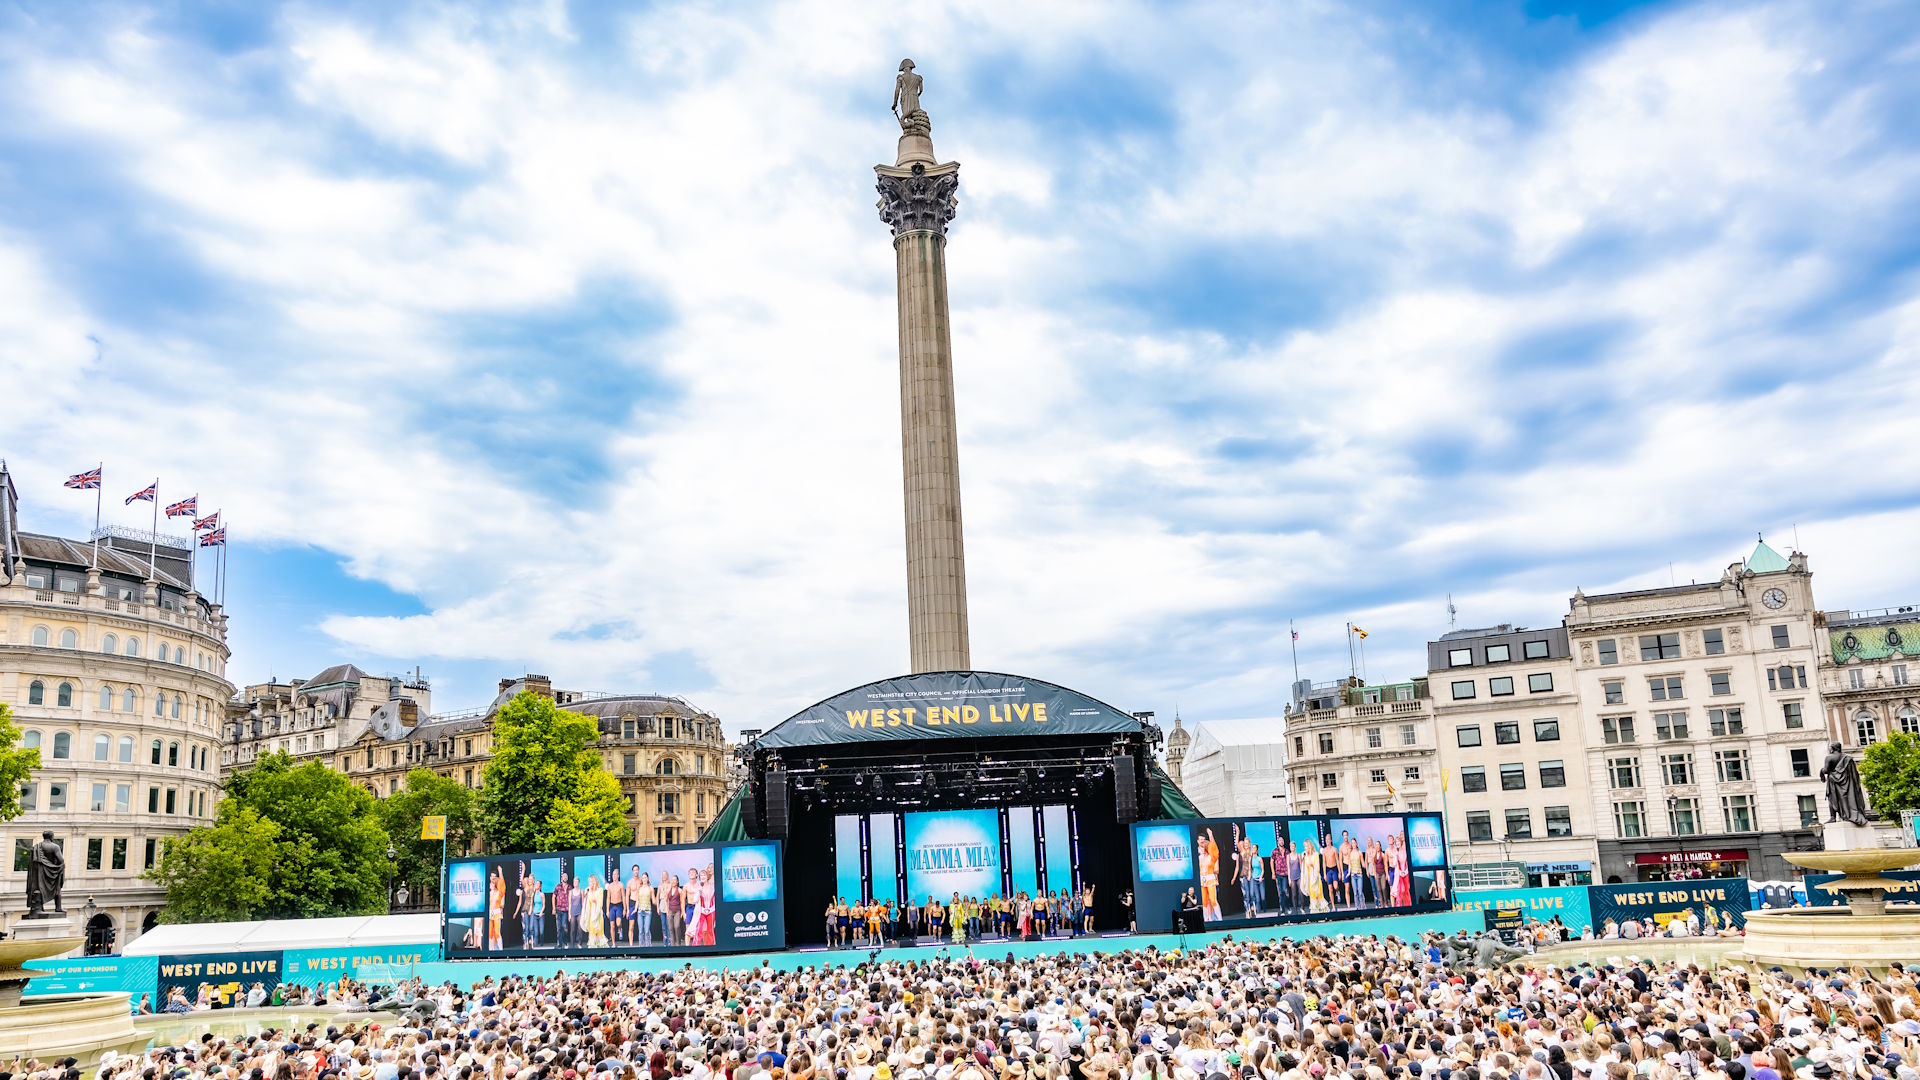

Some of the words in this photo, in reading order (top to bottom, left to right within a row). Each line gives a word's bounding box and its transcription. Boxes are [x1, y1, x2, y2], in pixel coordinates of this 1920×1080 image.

[1592, 602, 1660, 617] CANADIAN
[1666, 595, 1721, 609] PACIFIC
[867, 690, 904, 698] WESTMINSTER
[846, 707, 917, 729] WEST
[926, 704, 981, 726] END
[989, 702, 1048, 723] LIVE
[1411, 836, 1430, 847] MAMMA
[909, 847, 962, 870] MAMMA
[965, 846, 997, 868] MIA!
[1140, 847, 1170, 860] MAMMA
[1171, 846, 1189, 858] MIA!
[1684, 853, 1689, 861] A
[1689, 852, 1712, 861] MANGER
[724, 867, 755, 880] MAMMA
[757, 866, 774, 878] MIA!
[451, 882, 470, 893] MAMMA
[1496, 898, 1526, 909] END
[1530, 897, 1564, 909] LIVE
[1614, 892, 1654, 905] WEST
[1658, 891, 1689, 903] END
[1692, 889, 1726, 901] LIVE
[84, 965, 118, 973] SPONSORS
[161, 964, 202, 977] WEST
[206, 962, 238, 975] END
[242, 960, 277, 973] LIVE
[307, 957, 348, 970] WEST
